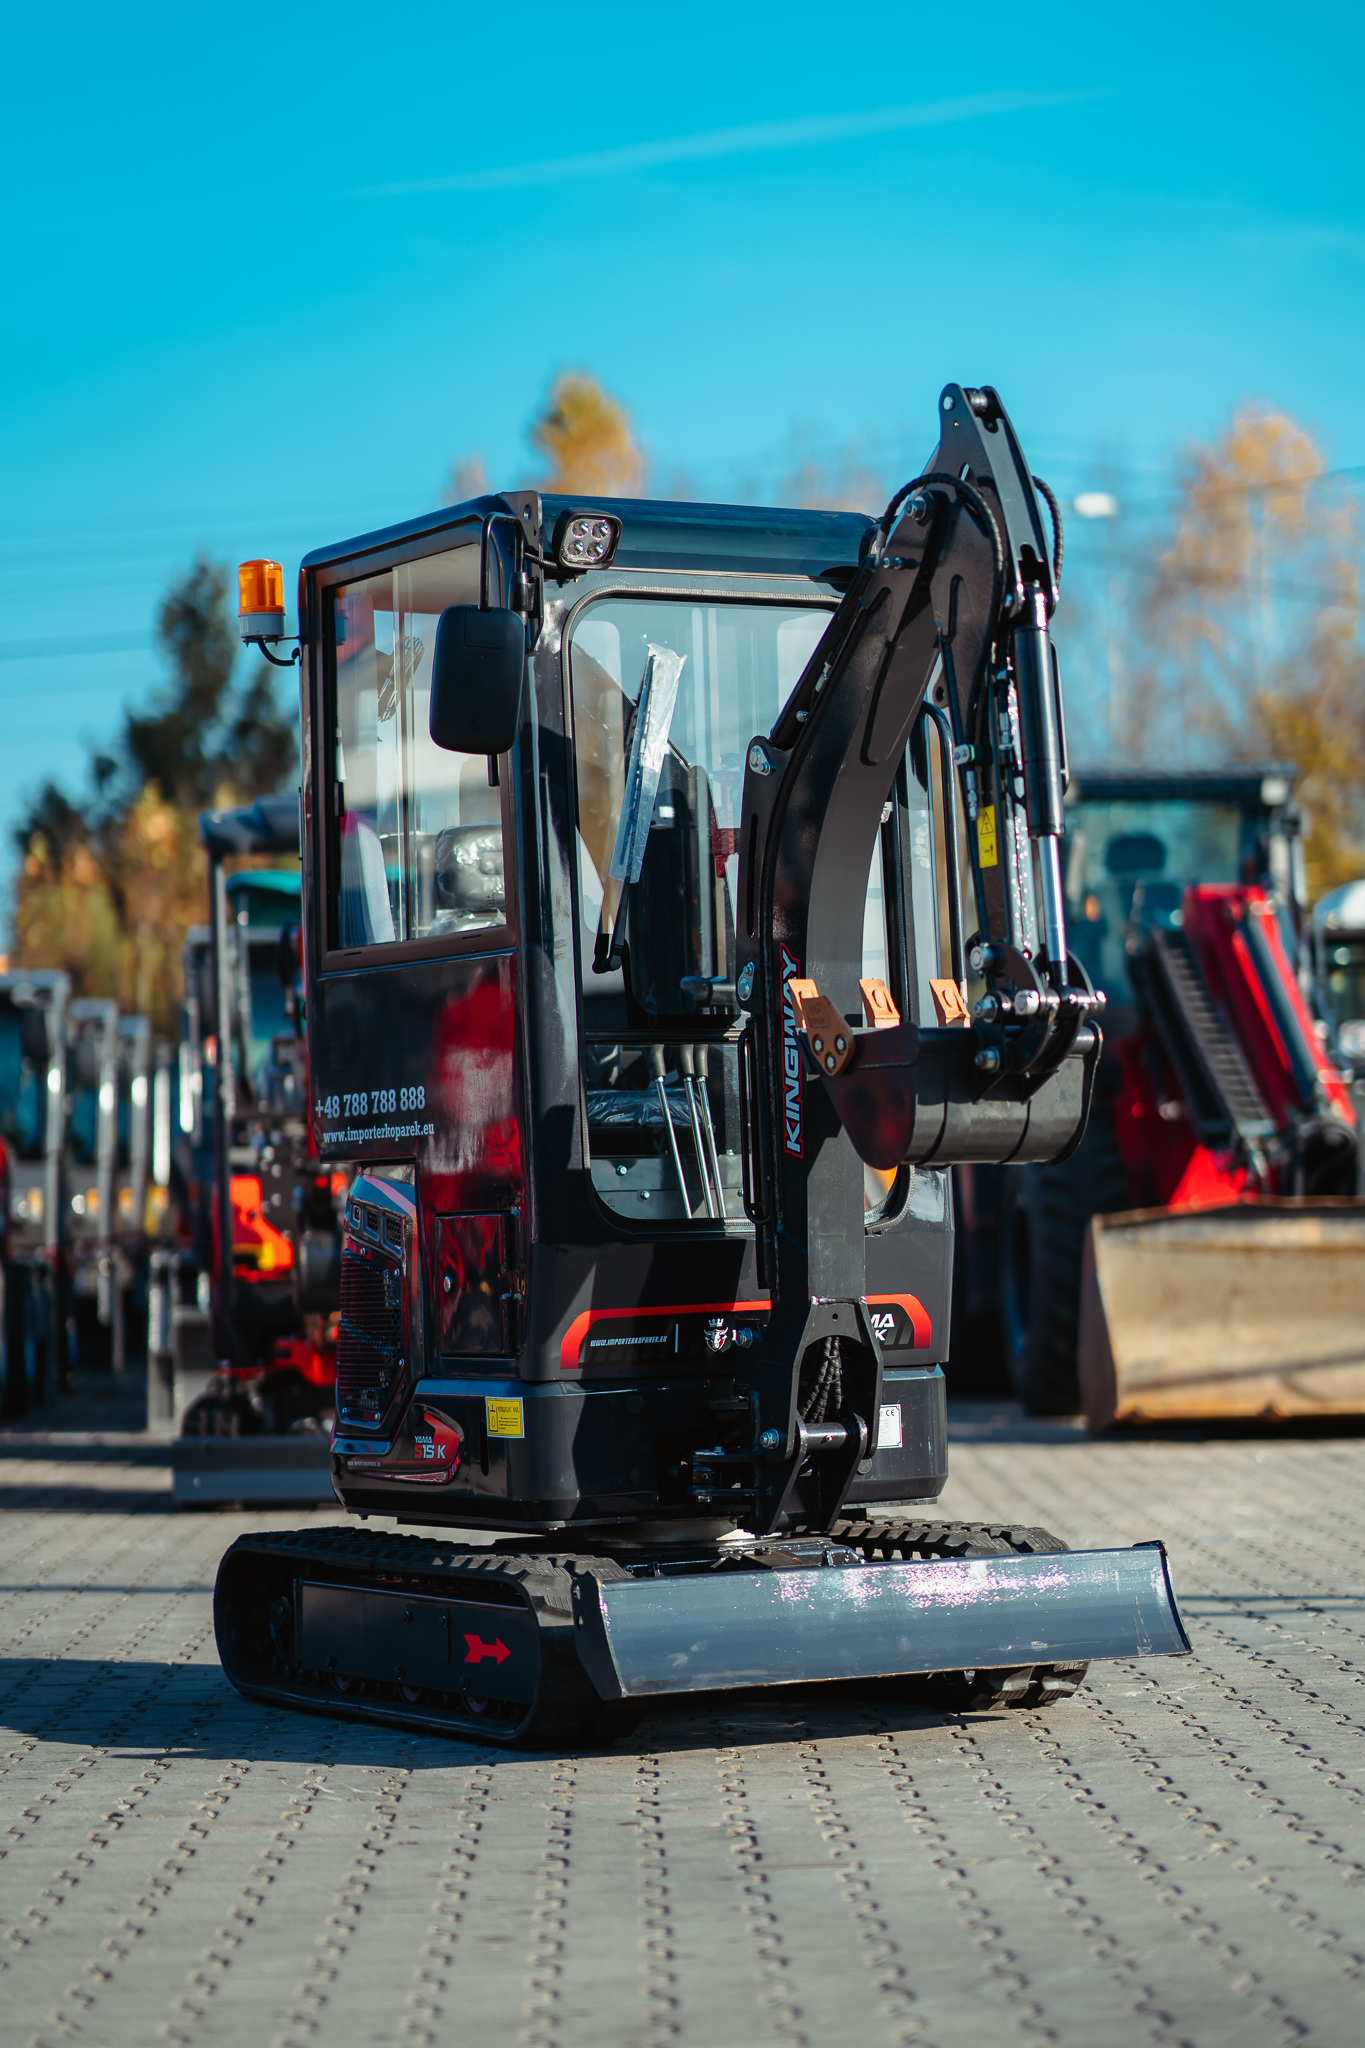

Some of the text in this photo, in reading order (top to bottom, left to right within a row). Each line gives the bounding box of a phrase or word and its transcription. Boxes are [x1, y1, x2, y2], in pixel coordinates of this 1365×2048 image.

[782, 948, 801, 1153] KINGWAY
[315, 1085, 426, 1119] +48 788 788 888
[323, 1120, 435, 1145] www.importerkoparek.eu
[414, 1435, 433, 1444] YAMA
[437, 1444, 447, 1459] K
